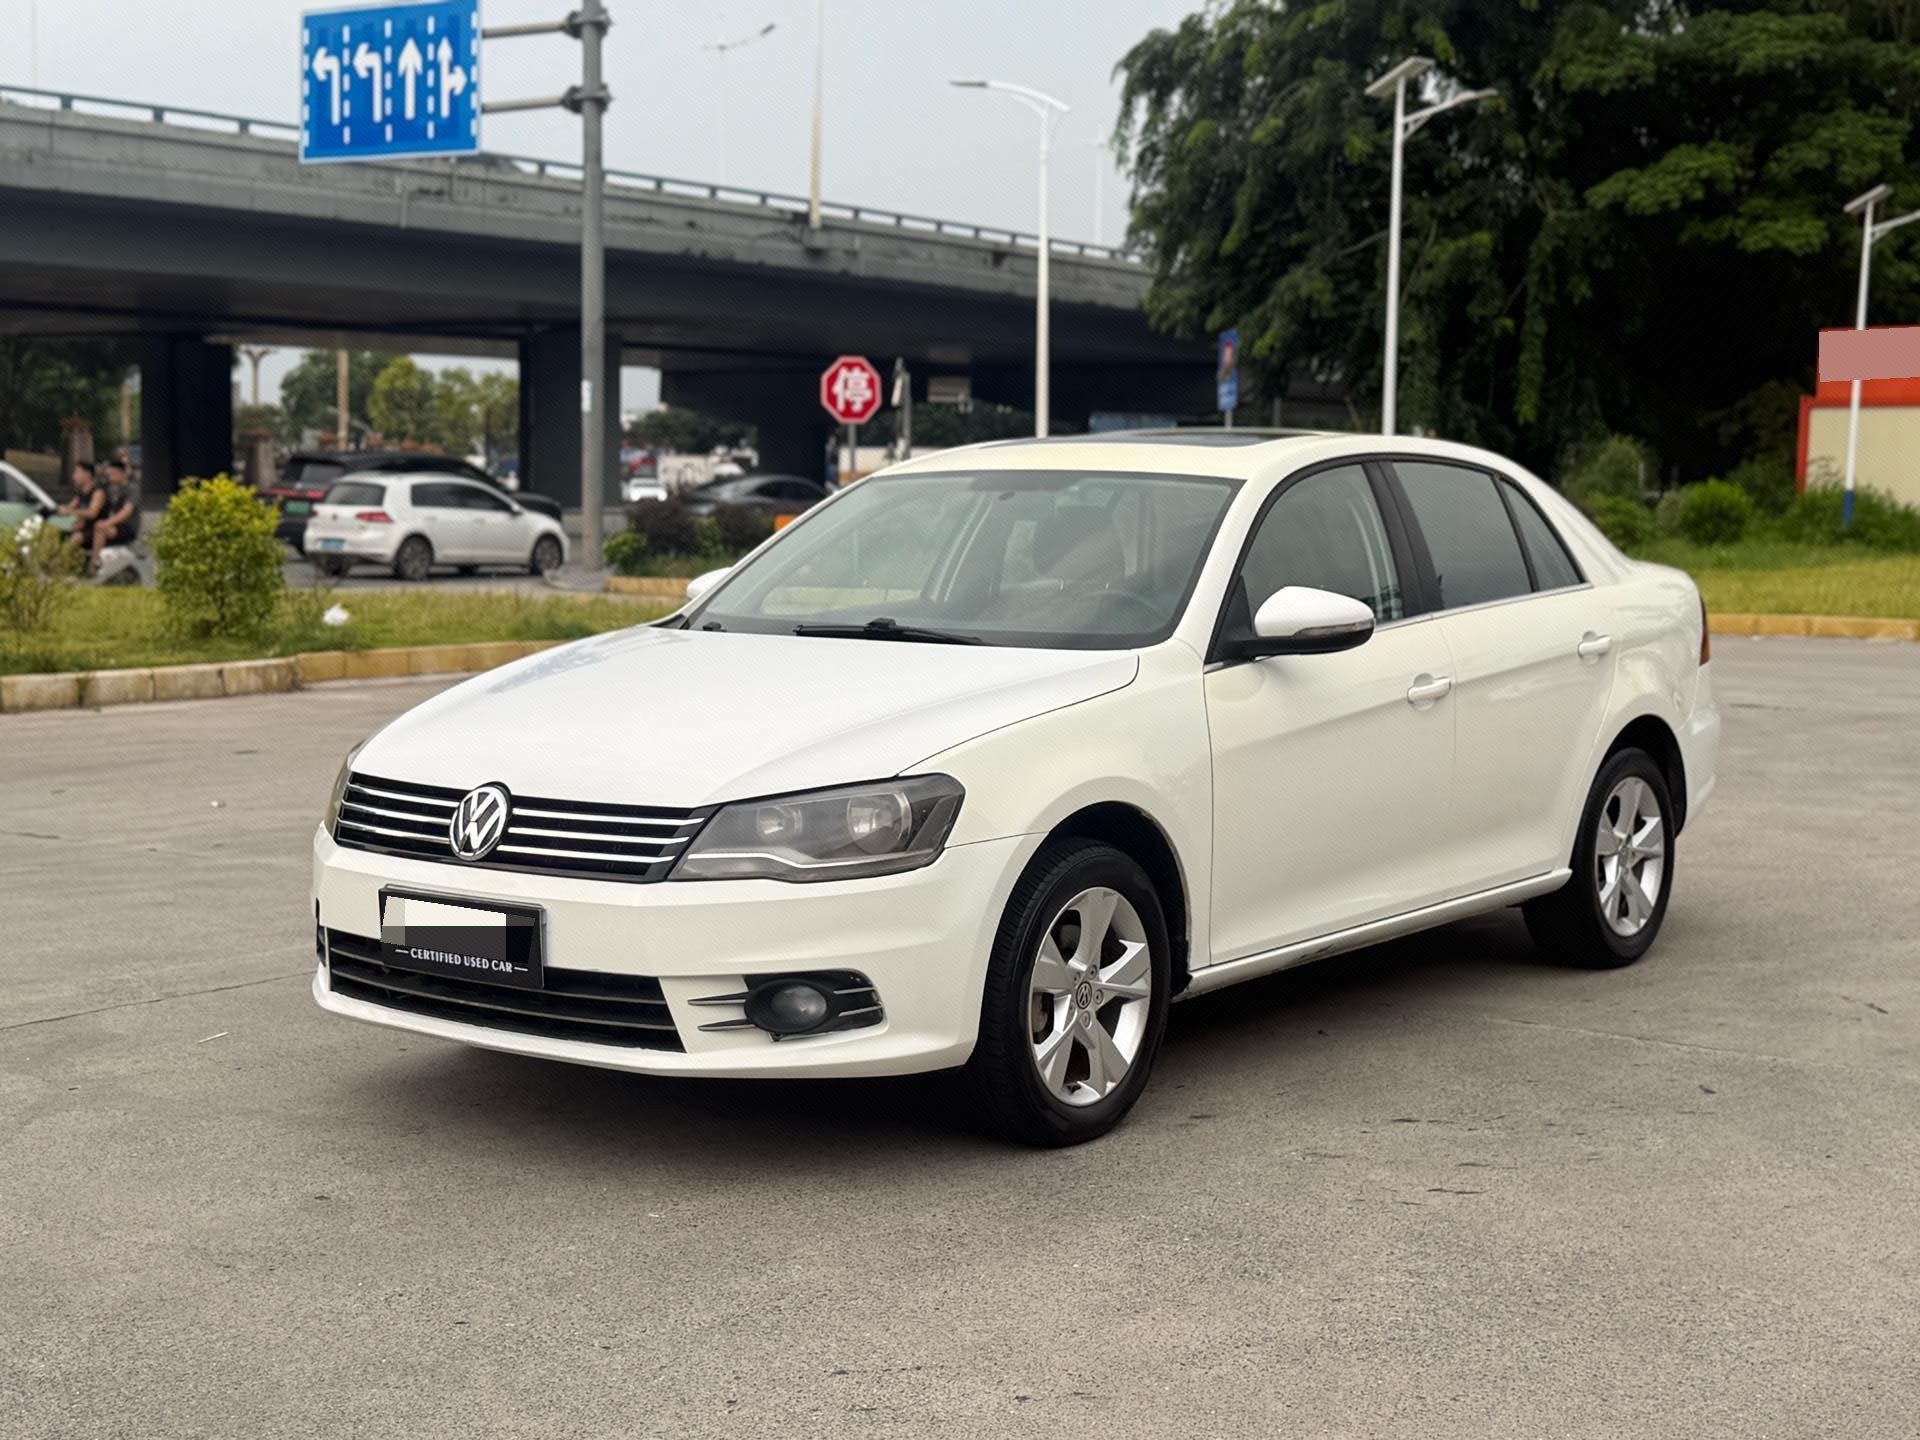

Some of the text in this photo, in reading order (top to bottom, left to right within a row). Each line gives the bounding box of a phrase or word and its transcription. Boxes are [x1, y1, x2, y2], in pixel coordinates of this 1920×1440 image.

[831, 366, 874, 413] 停
[410, 948, 513, 973] CERTIFIED USED CAR
